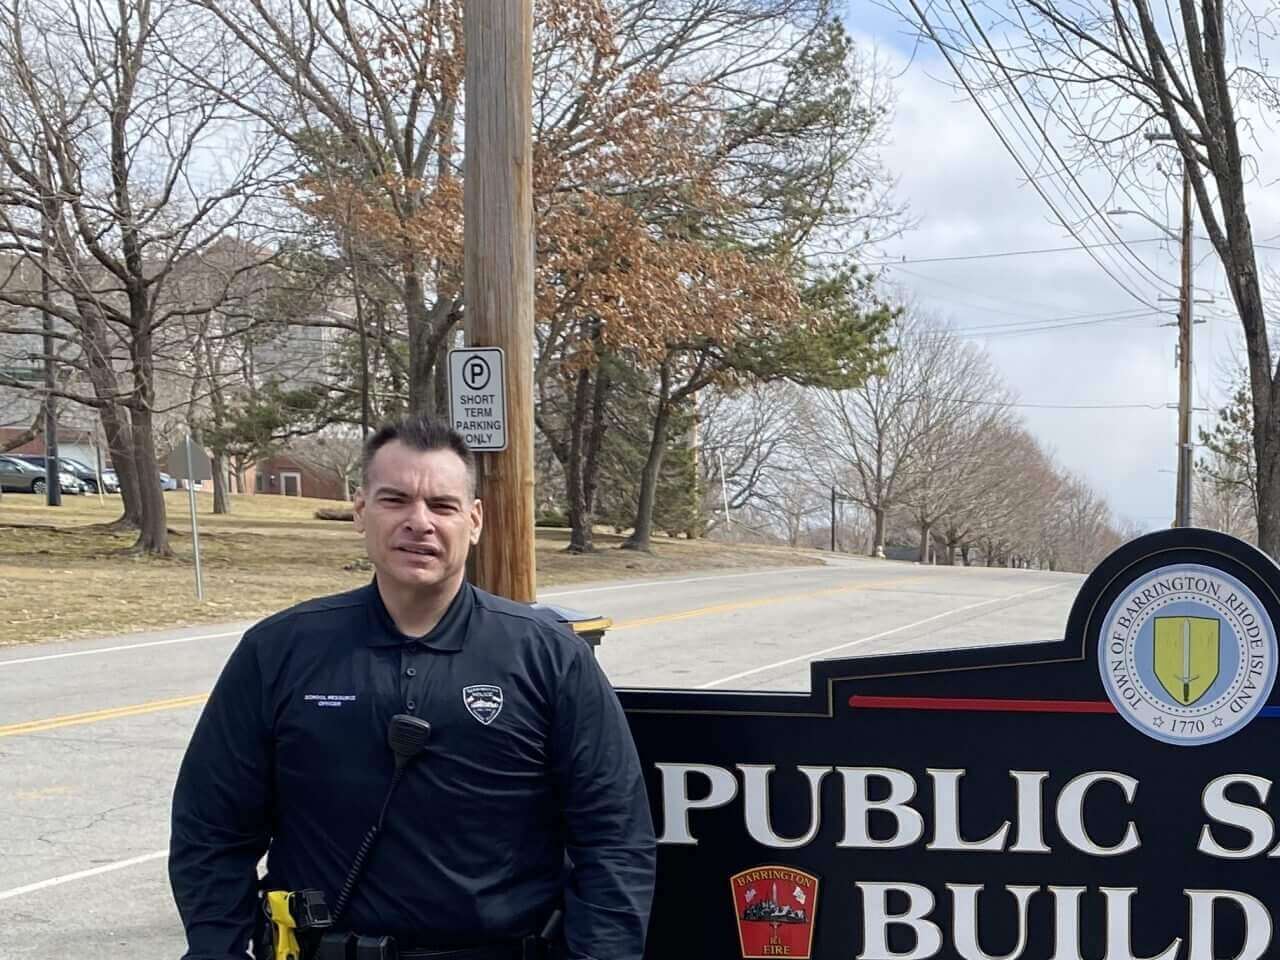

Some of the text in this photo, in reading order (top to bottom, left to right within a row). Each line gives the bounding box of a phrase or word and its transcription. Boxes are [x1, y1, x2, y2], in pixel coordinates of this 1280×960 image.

[470, 363, 484, 384] P
[460, 394, 495, 406] SHORT
[464, 407, 492, 418] TERM
[456, 420, 501, 431] PARKING
[465, 432, 493, 445] ONLY
[1224, 592, 1264, 649] RHODE
[1110, 631, 1126, 655] OF
[1111, 660, 1143, 710] TOWN
[1229, 653, 1265, 713] ISLAND
[1170, 718, 1206, 734] 1770
[655, 763, 1141, 856] PUBLIC
[736, 870, 811, 887] BARRINGTON
[763, 944, 791, 955] FIRE
